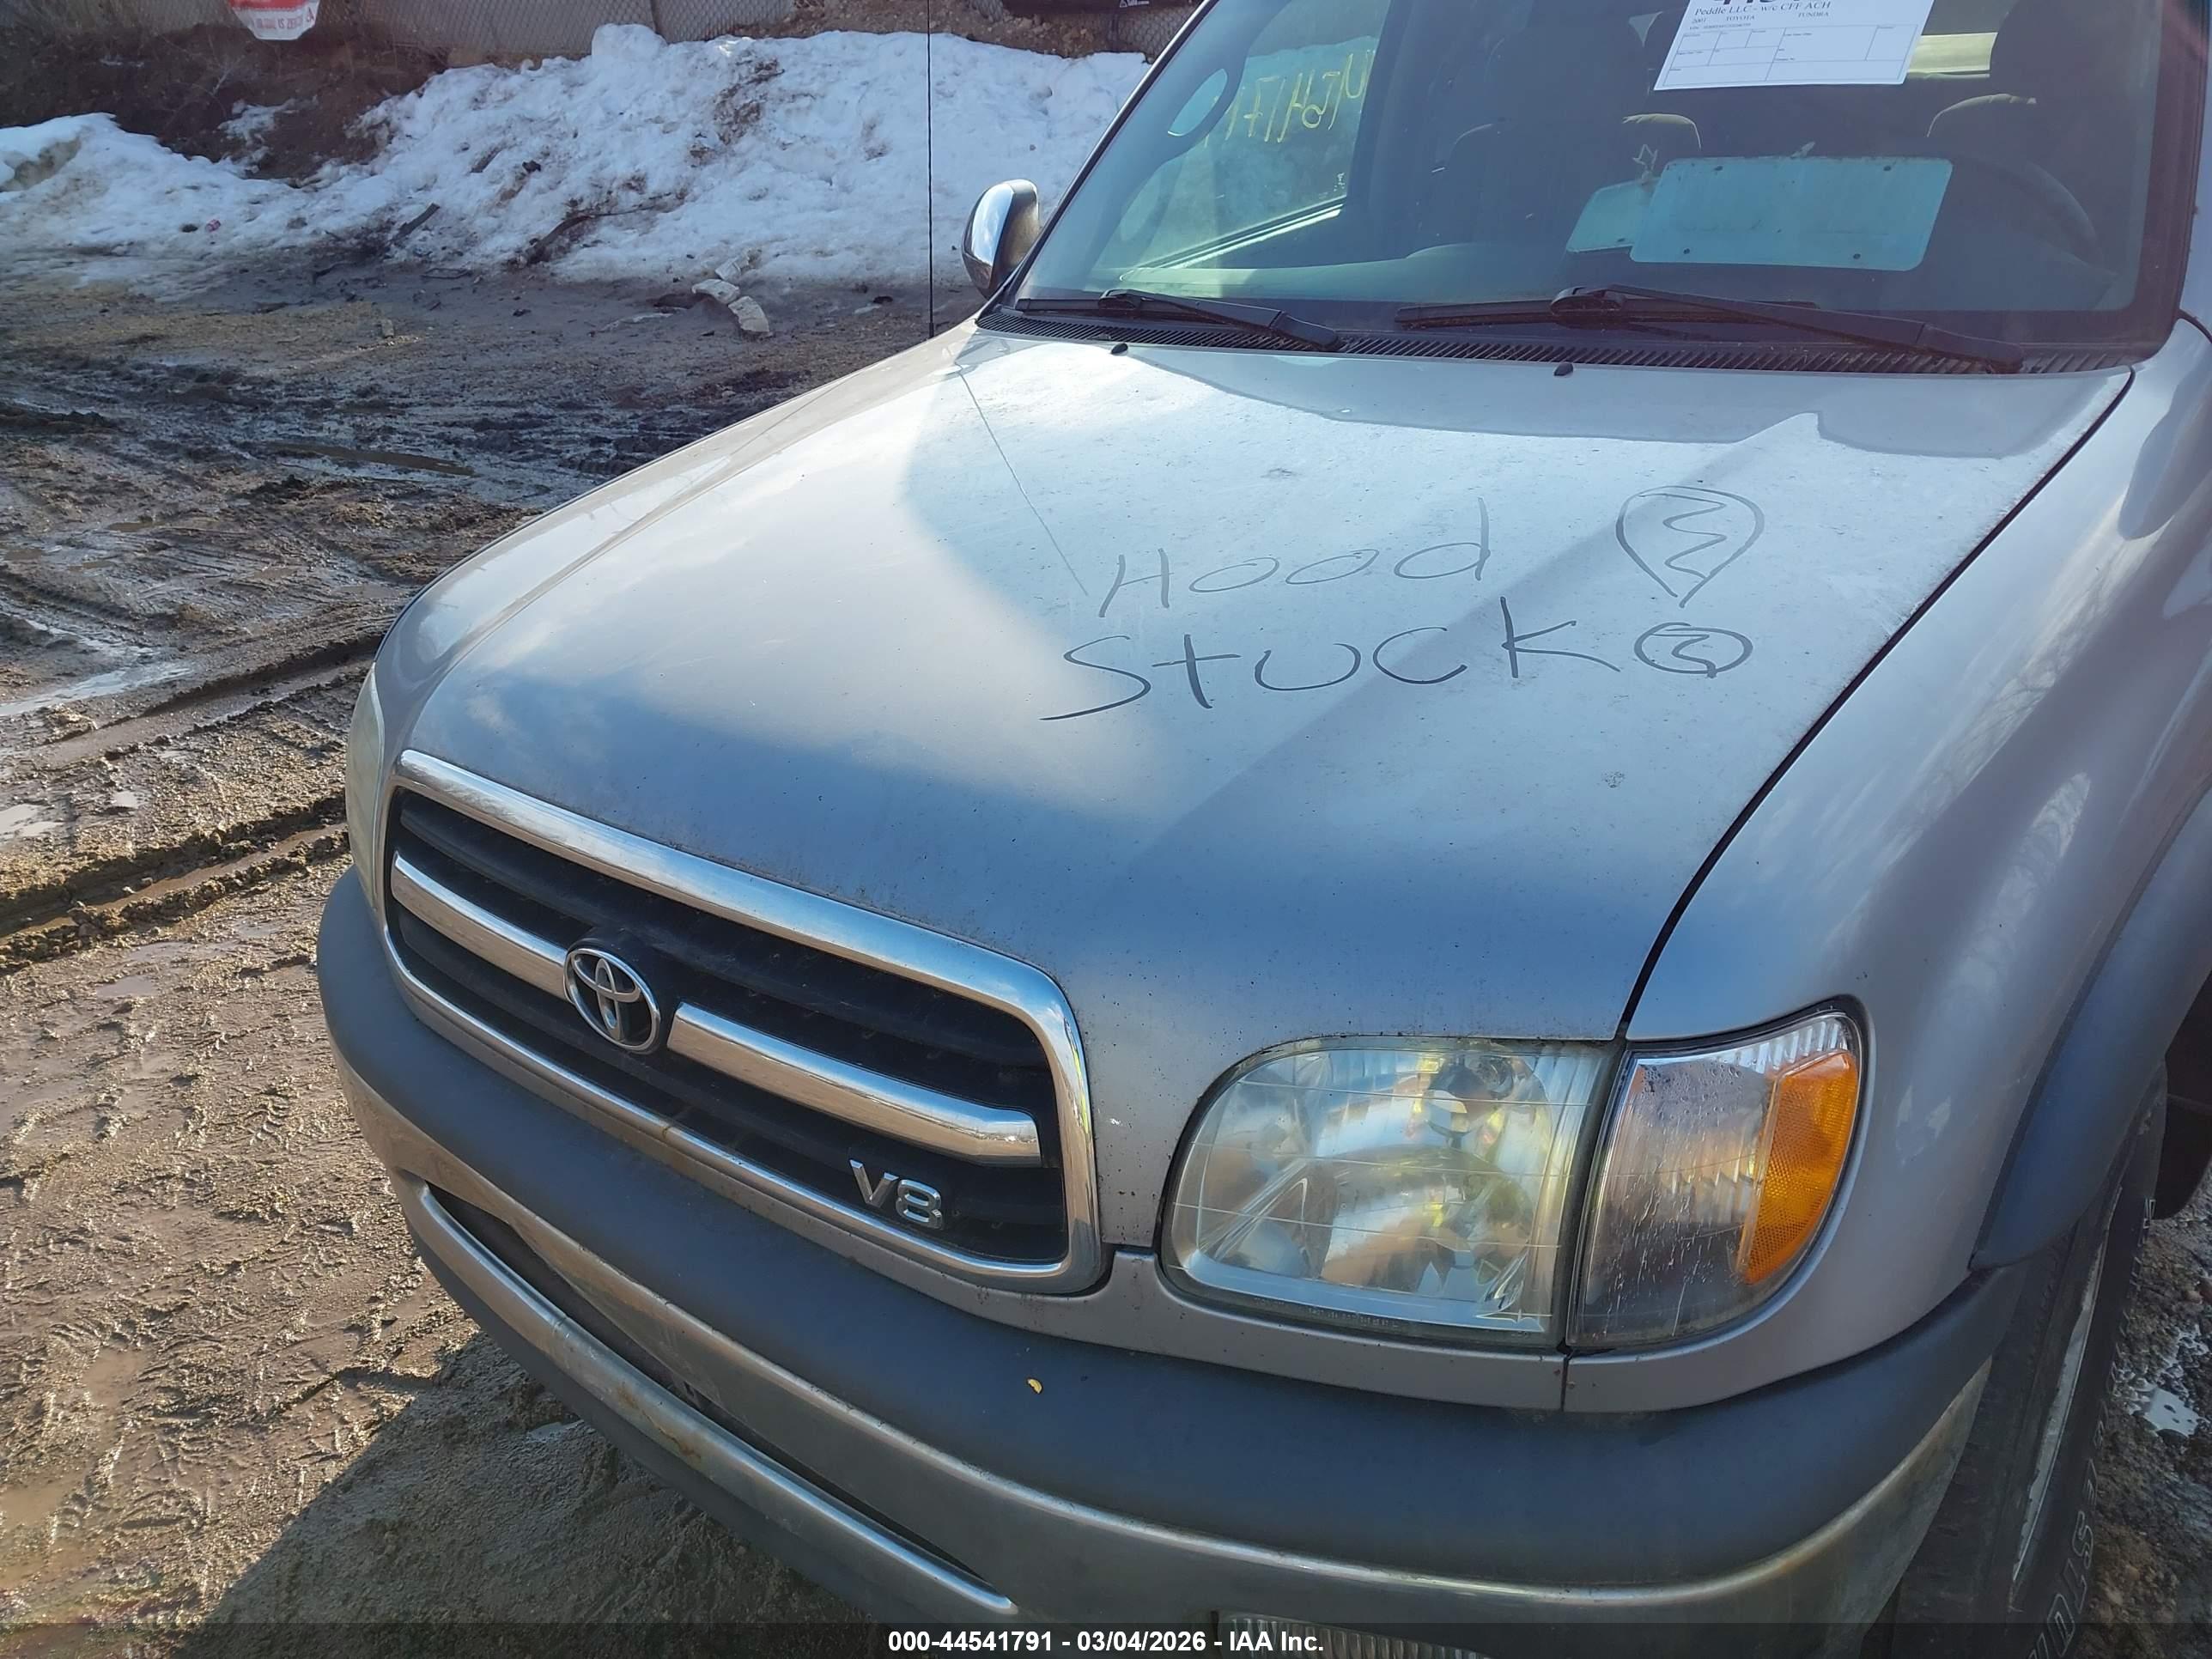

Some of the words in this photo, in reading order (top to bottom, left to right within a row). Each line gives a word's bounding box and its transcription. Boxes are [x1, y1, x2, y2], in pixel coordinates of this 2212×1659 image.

[1694, 7, 1726, 15] Peddle
[1099, 496, 1491, 618] Hood
[849, 1159, 943, 1230] V8
